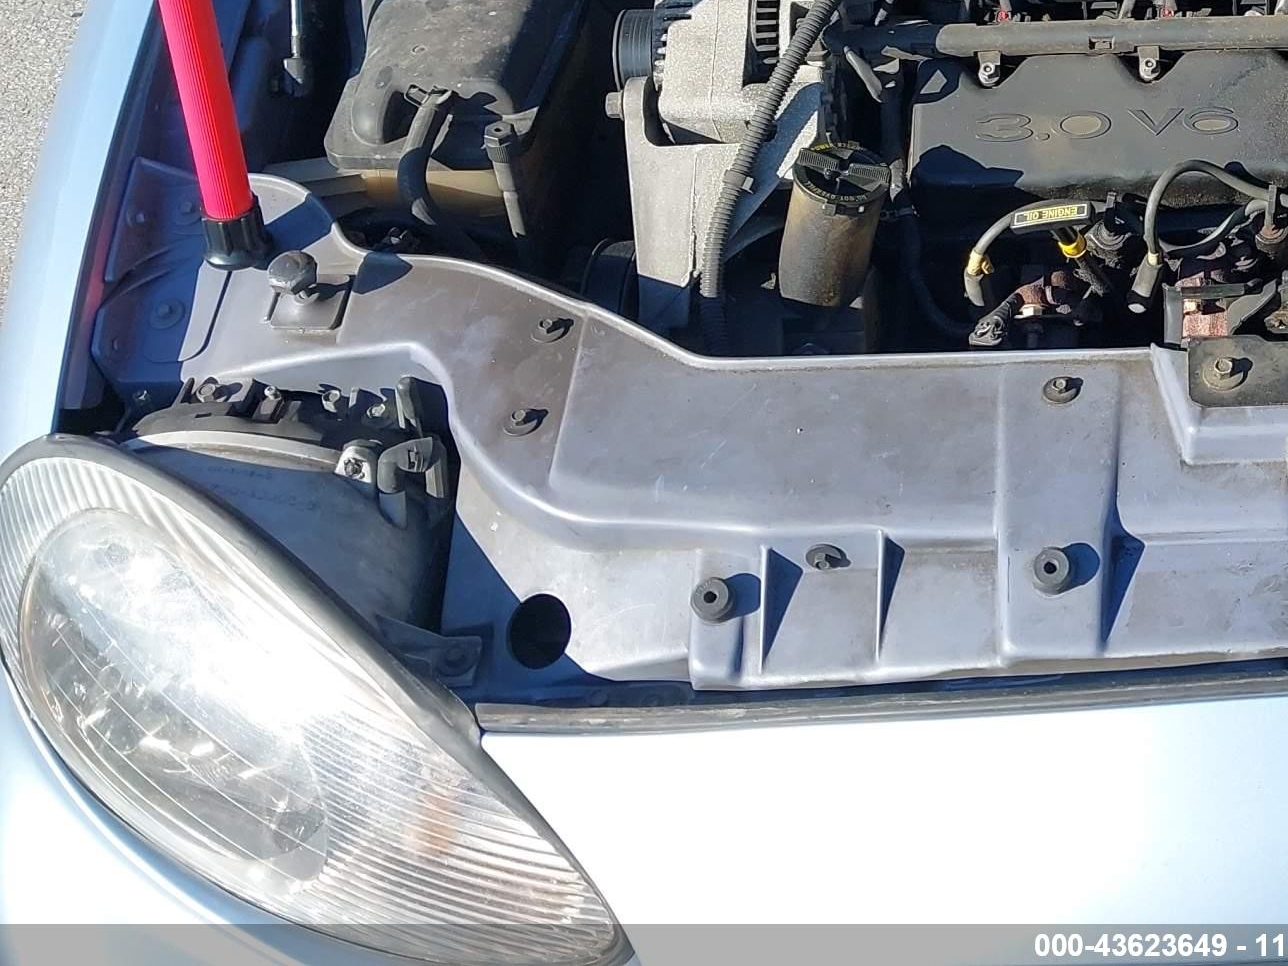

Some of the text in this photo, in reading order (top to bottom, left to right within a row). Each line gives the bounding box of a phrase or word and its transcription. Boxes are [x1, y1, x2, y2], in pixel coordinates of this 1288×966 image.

[976, 105, 1240, 143] 3.0 V6
[1024, 206, 1078, 221] ENGINE OIL
